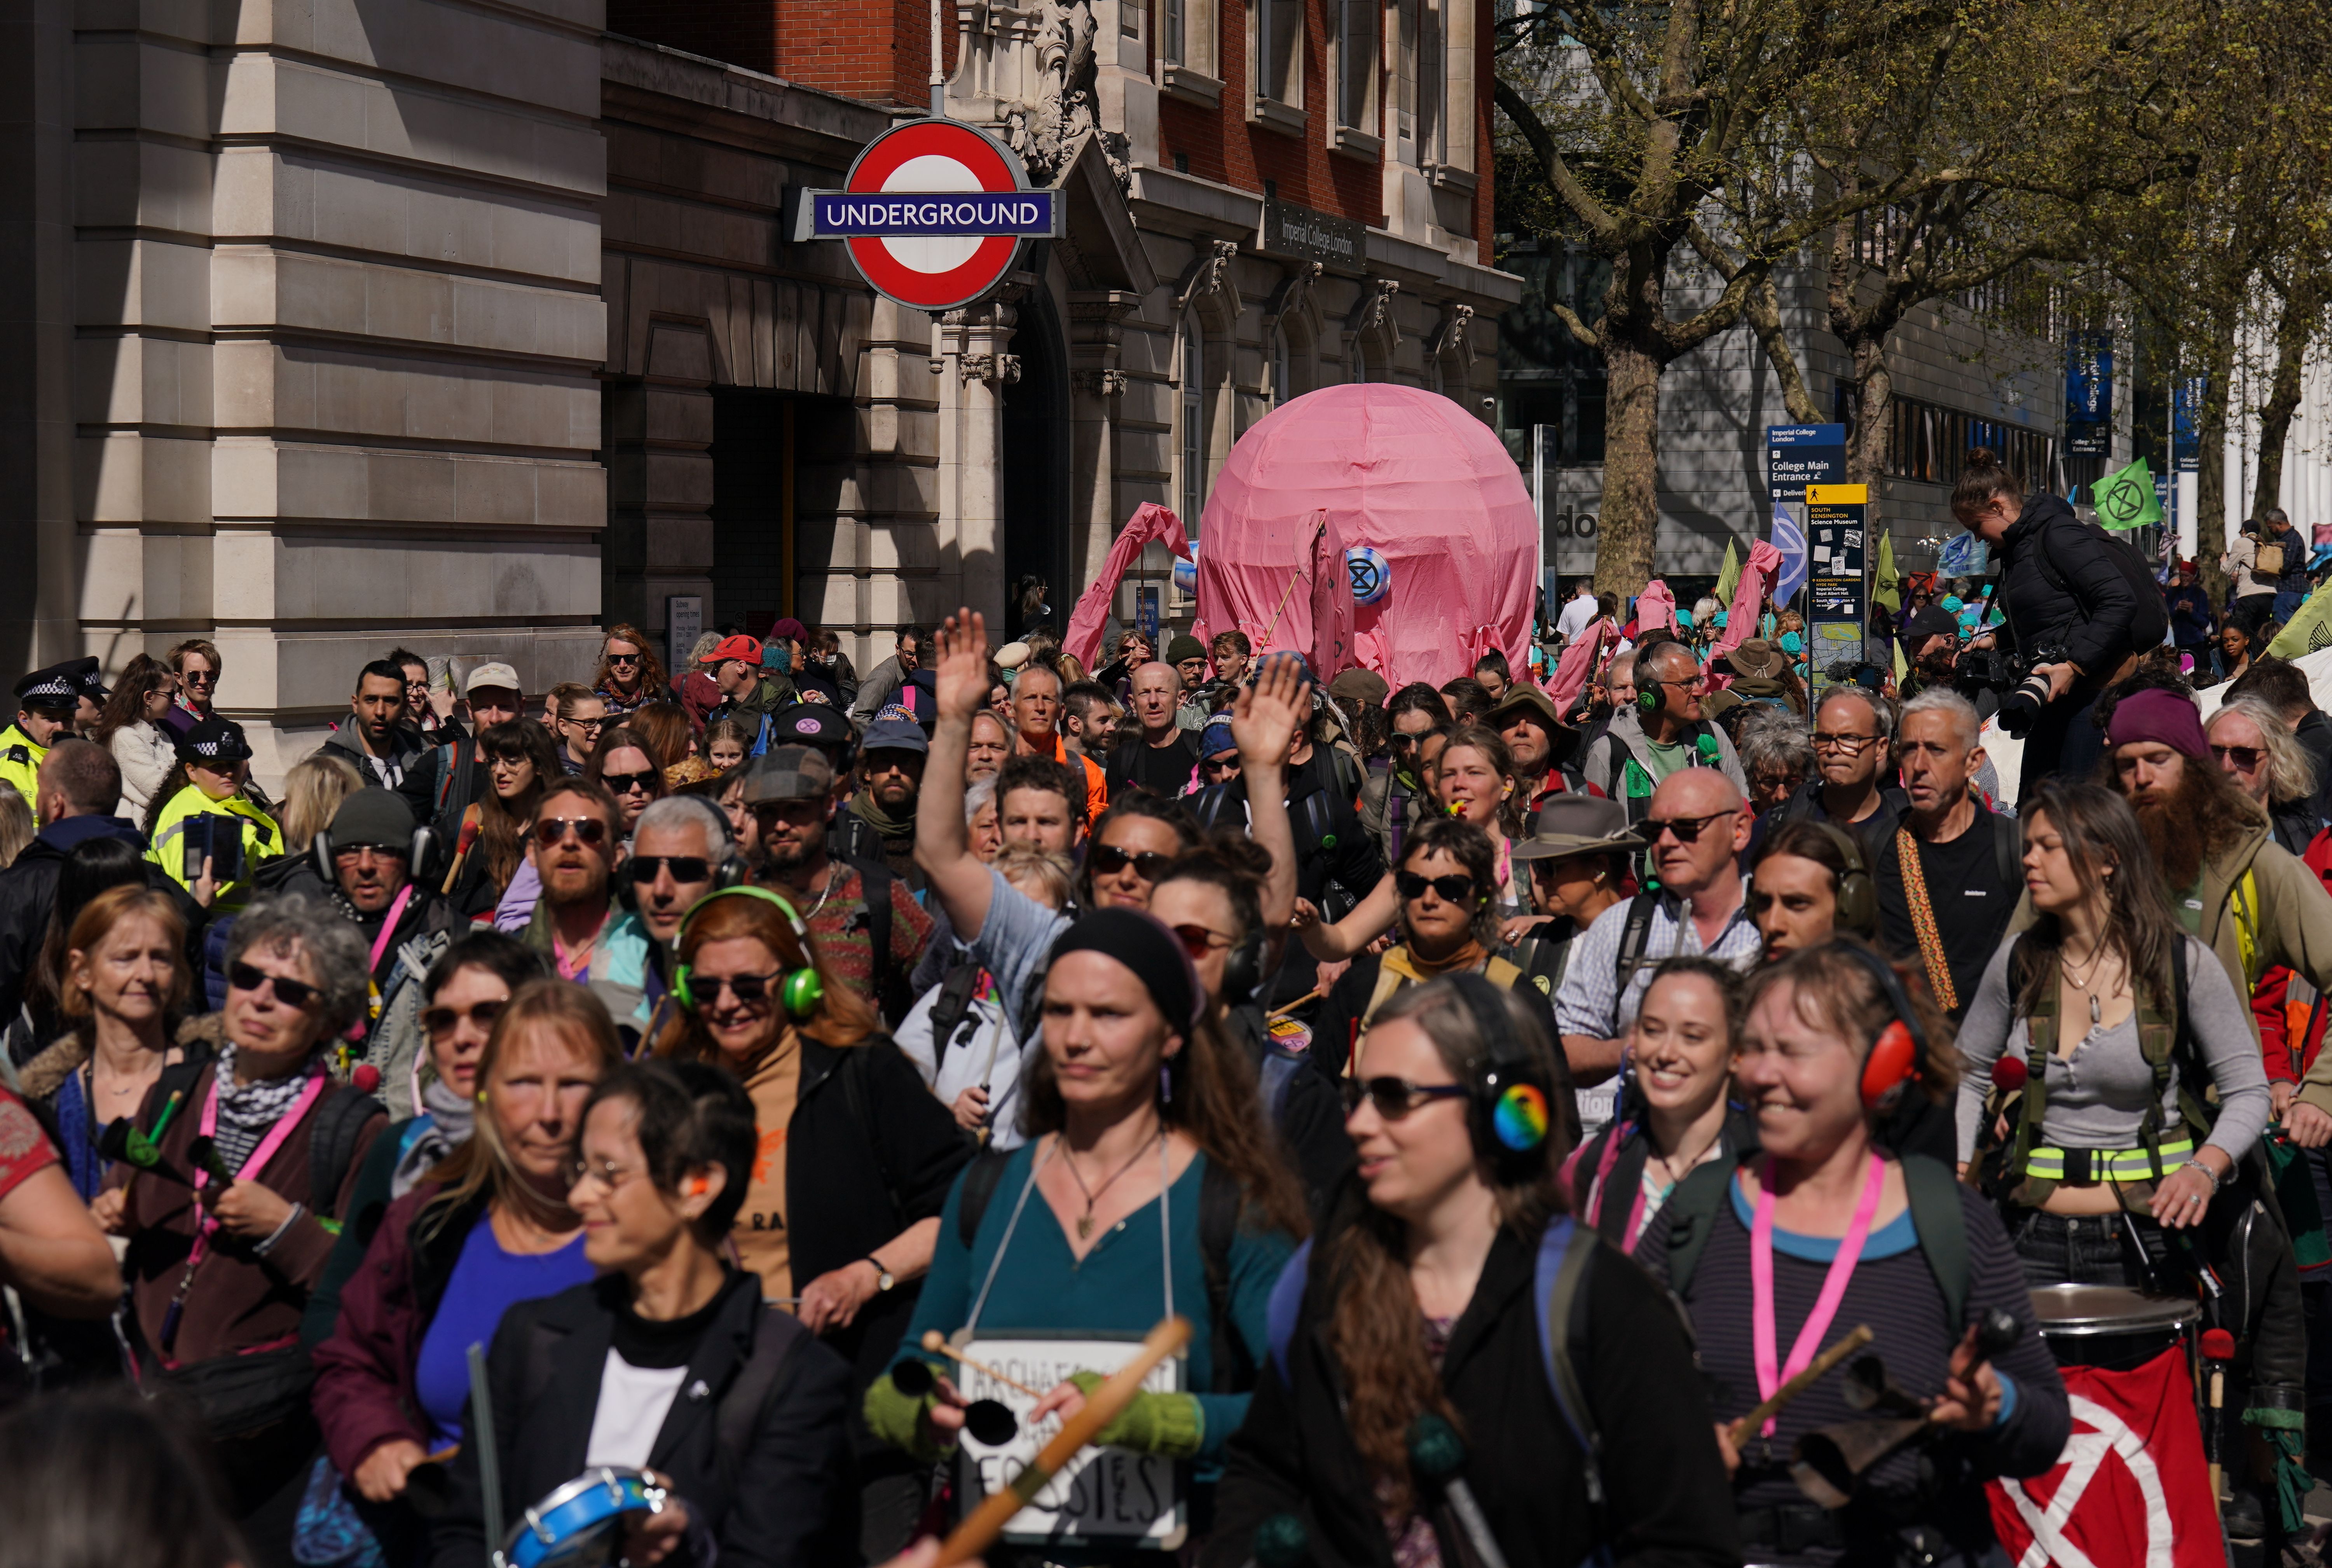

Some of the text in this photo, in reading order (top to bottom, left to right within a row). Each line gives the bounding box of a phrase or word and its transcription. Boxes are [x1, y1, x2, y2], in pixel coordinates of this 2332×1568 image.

[827, 203, 1038, 226] UNDERGROUND
[1283, 217, 1352, 255] Imperial College London
[1772, 461, 1829, 472] College Main
[1772, 473, 1811, 481] Entrance
[676, 601, 689, 609] Subway
[676, 611, 689, 619] opening
